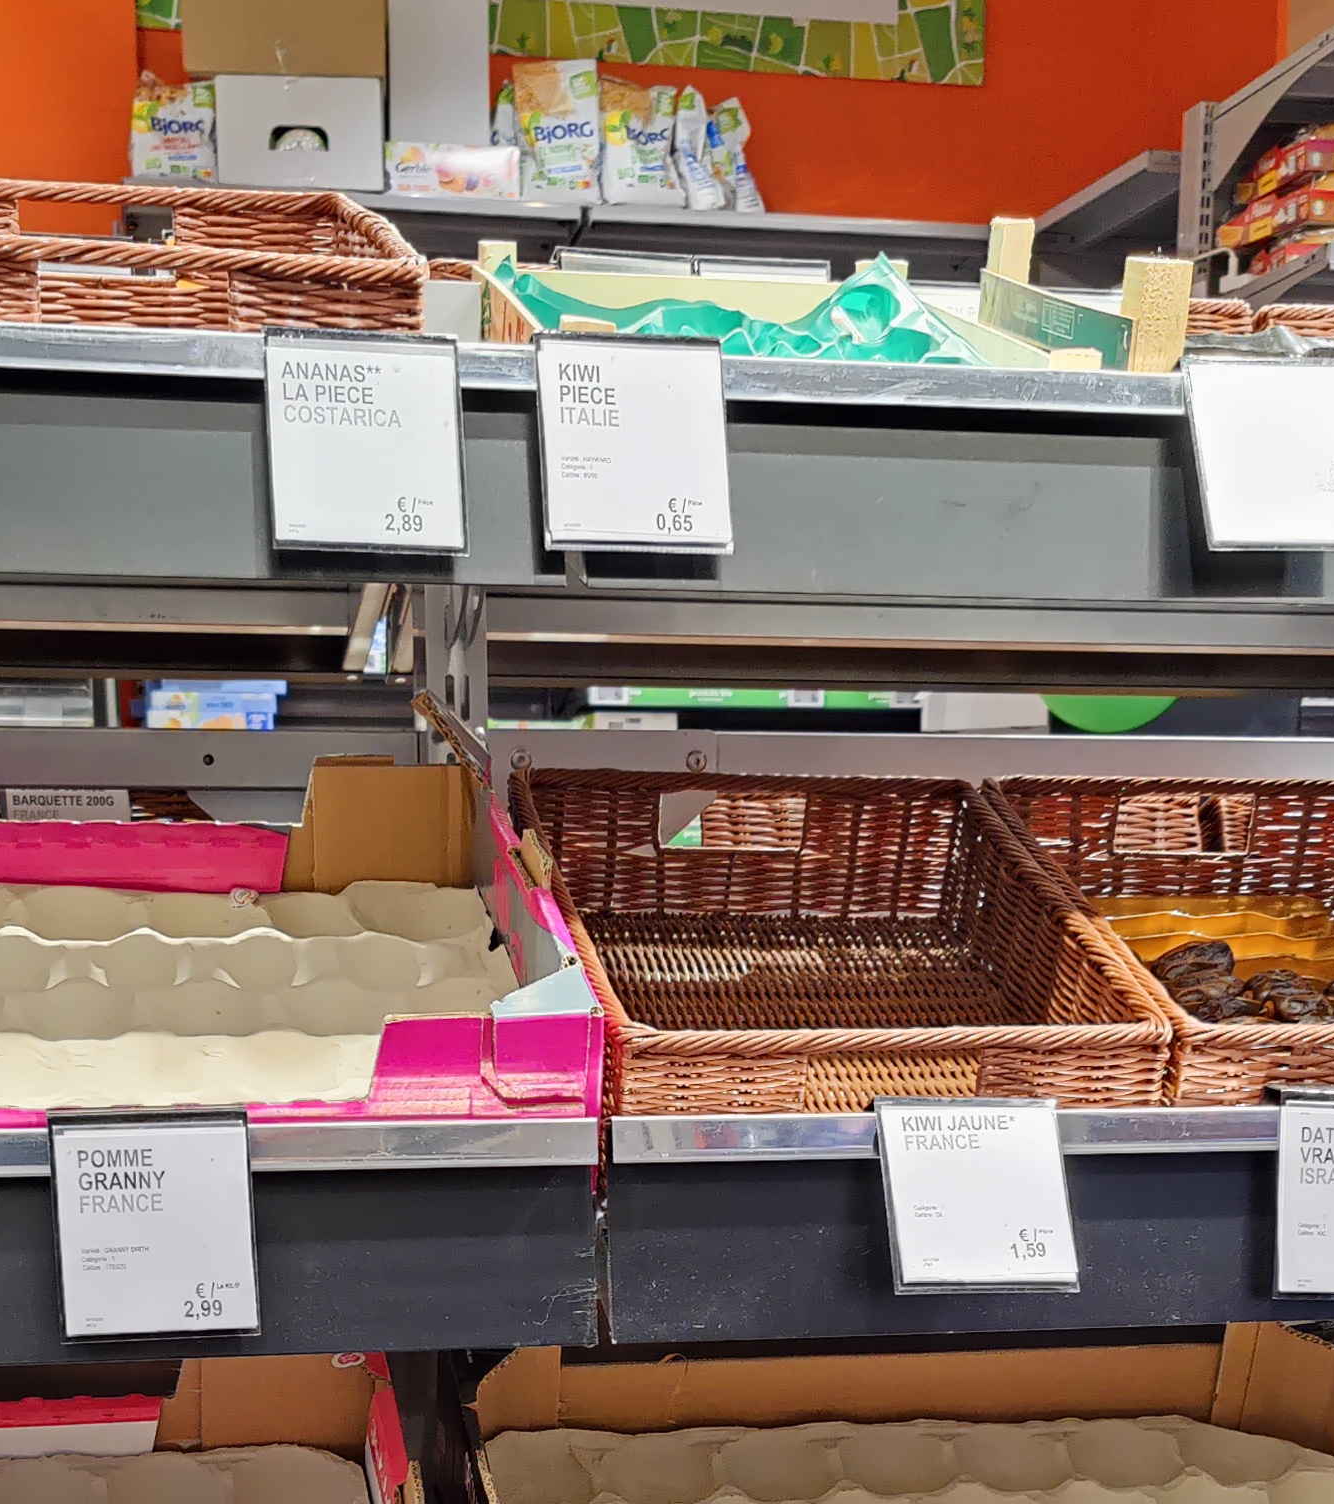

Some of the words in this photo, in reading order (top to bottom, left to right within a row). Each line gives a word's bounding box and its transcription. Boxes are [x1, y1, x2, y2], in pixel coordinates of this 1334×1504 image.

[558, 363, 601, 384] KIWI
[283, 384, 309, 404] LA
[314, 385, 375, 406] PIECE
[559, 385, 617, 406] PIECE
[283, 405, 403, 429] COSTARICA
[559, 407, 620, 428] ITALIE
[384, 513, 424, 536] 2,89
[656, 514, 694, 535] 0,65
[12, 795, 83, 807] BARQUETTE
[86, 796, 115, 807] 200G
[902, 1116, 942, 1132] KIWI
[904, 1133, 981, 1151] FRANCE
[77, 1148, 154, 1168] POMME
[78, 1170, 166, 1191] GRANNY
[80, 1193, 164, 1214] FRANCE
[1010, 1242, 1047, 1261] 1,59
[184, 1300, 224, 1321] 2,99
